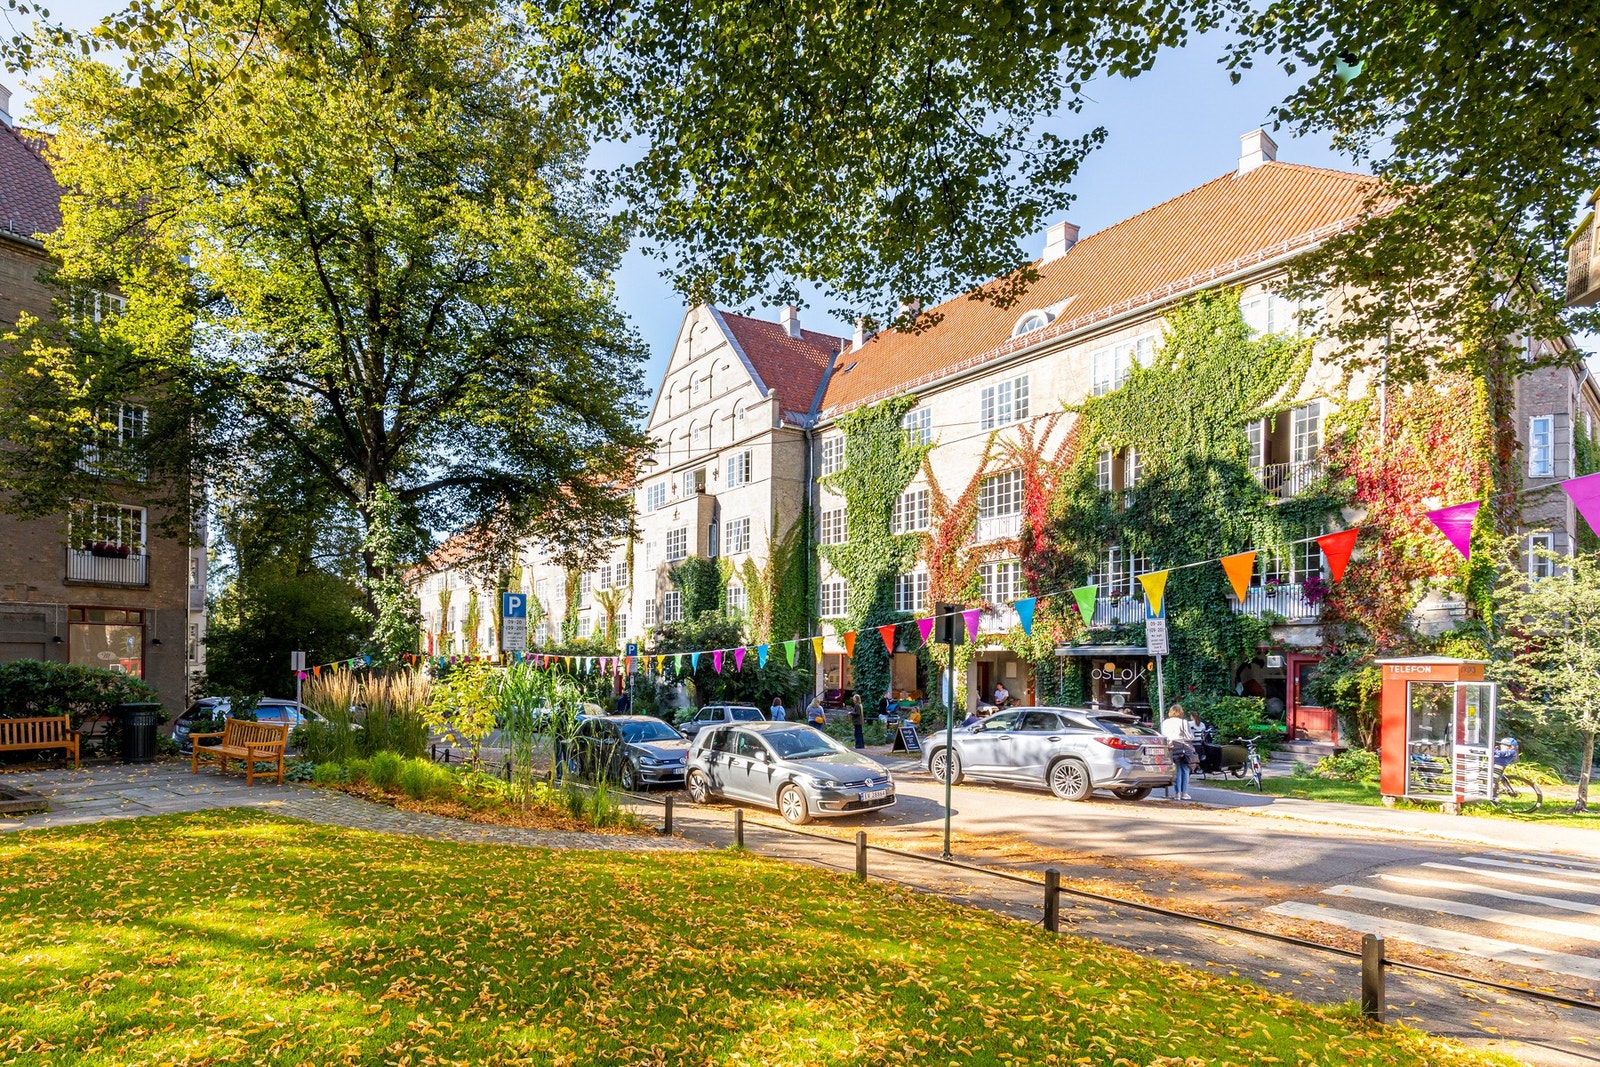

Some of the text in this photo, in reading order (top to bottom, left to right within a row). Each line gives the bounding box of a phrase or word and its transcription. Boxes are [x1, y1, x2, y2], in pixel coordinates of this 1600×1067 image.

[508, 596, 521, 615] P
[628, 644, 635, 655] P
[1389, 665, 1432, 673] TELEFON
